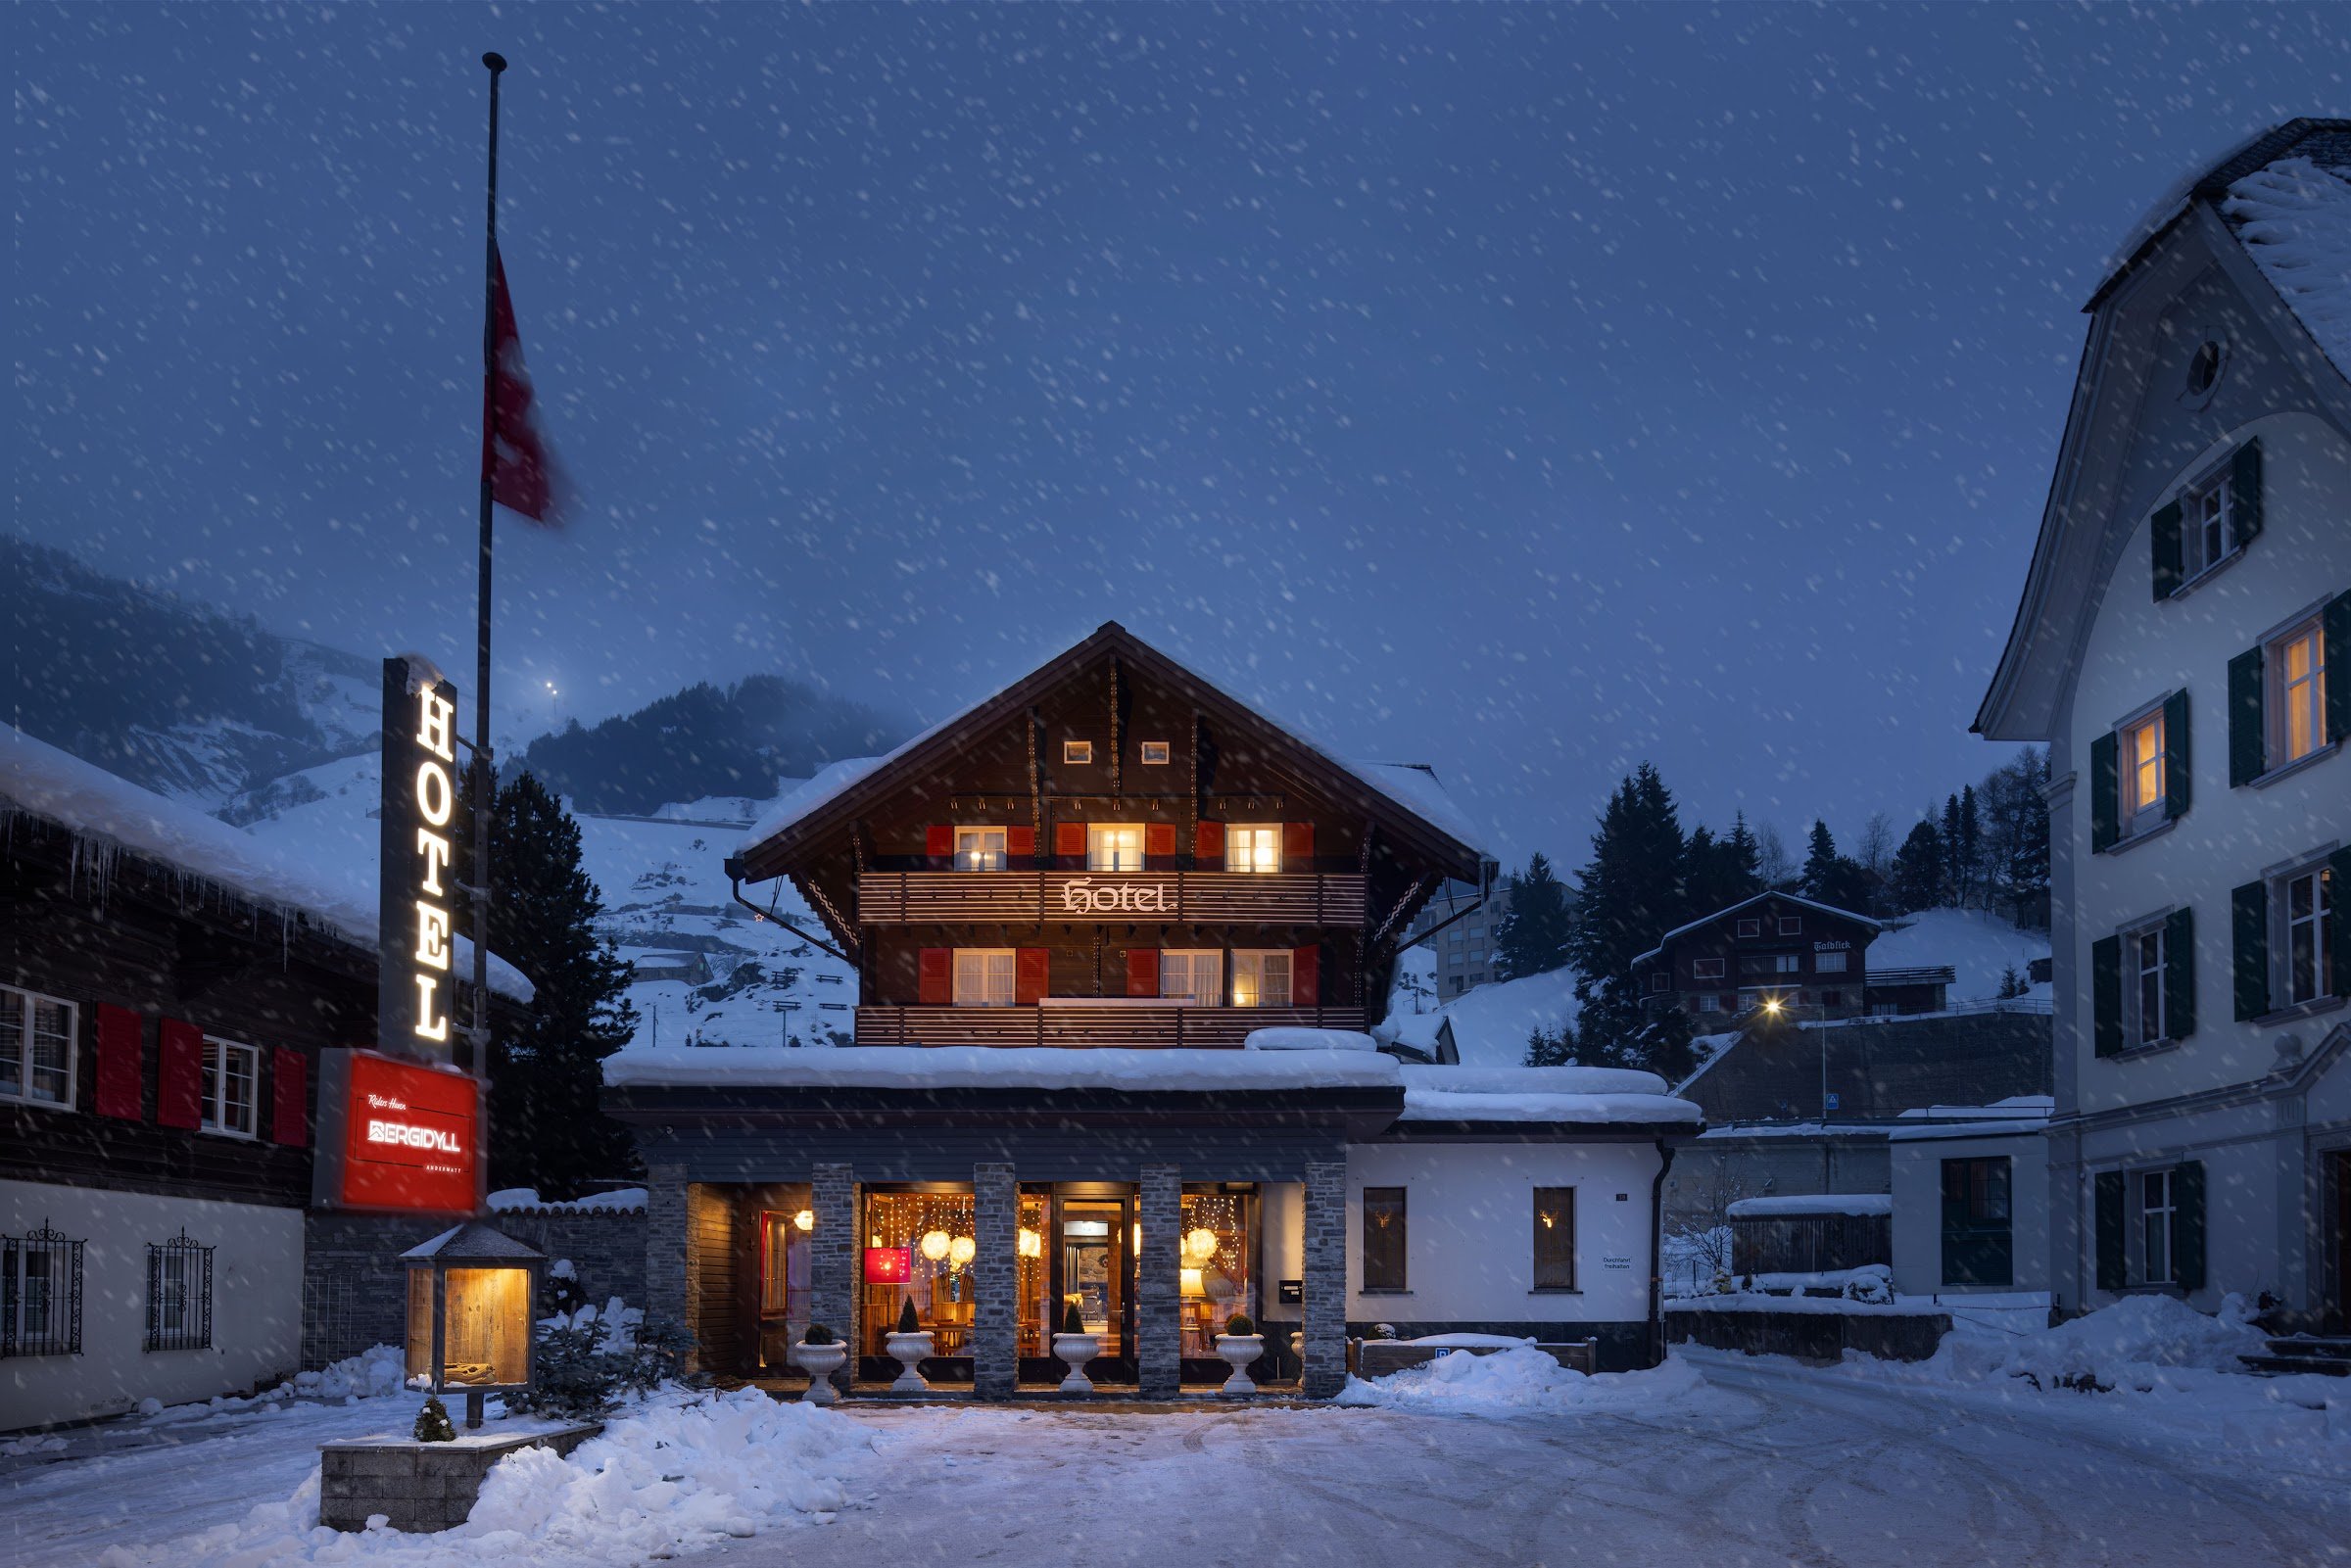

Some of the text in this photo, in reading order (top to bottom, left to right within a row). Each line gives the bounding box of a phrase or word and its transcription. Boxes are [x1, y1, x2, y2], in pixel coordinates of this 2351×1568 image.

[415, 687, 454, 1041] HOTEL
[1061, 877, 1177, 914] Hotel
[368, 1094, 387, 1109] Riders
[367, 1120, 460, 1153] BERGIDYLL
[426, 1164, 461, 1173] ANDERMATT
